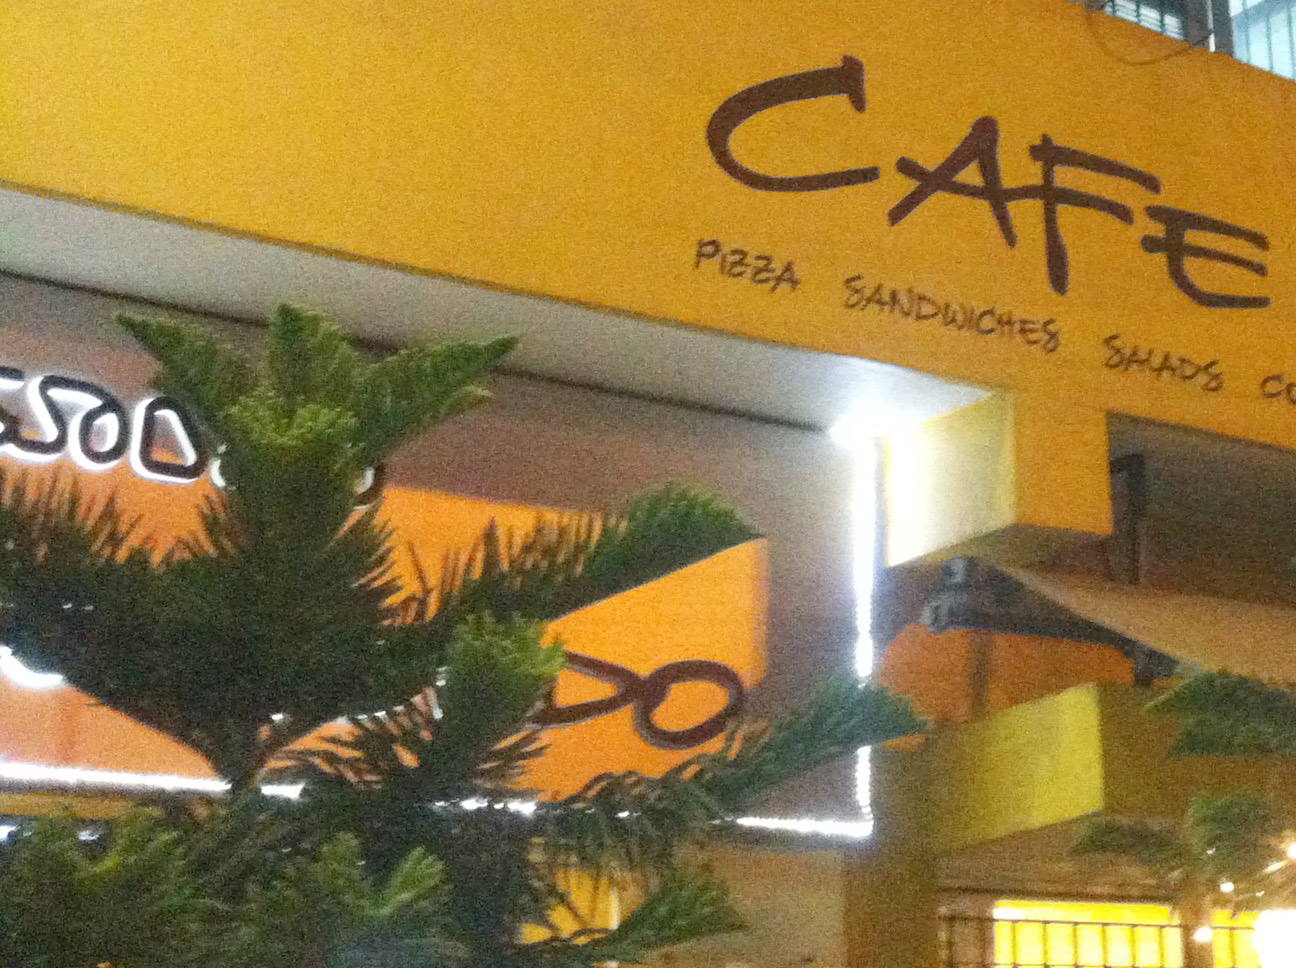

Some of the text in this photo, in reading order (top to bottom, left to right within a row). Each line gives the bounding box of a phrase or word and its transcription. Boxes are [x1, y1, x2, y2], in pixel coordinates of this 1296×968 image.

[705, 54, 1272, 309] CAFE
[695, 238, 800, 291] PIZZA
[842, 274, 1062, 353] SANDWICHES
[1104, 335, 1224, 392] SALADS
